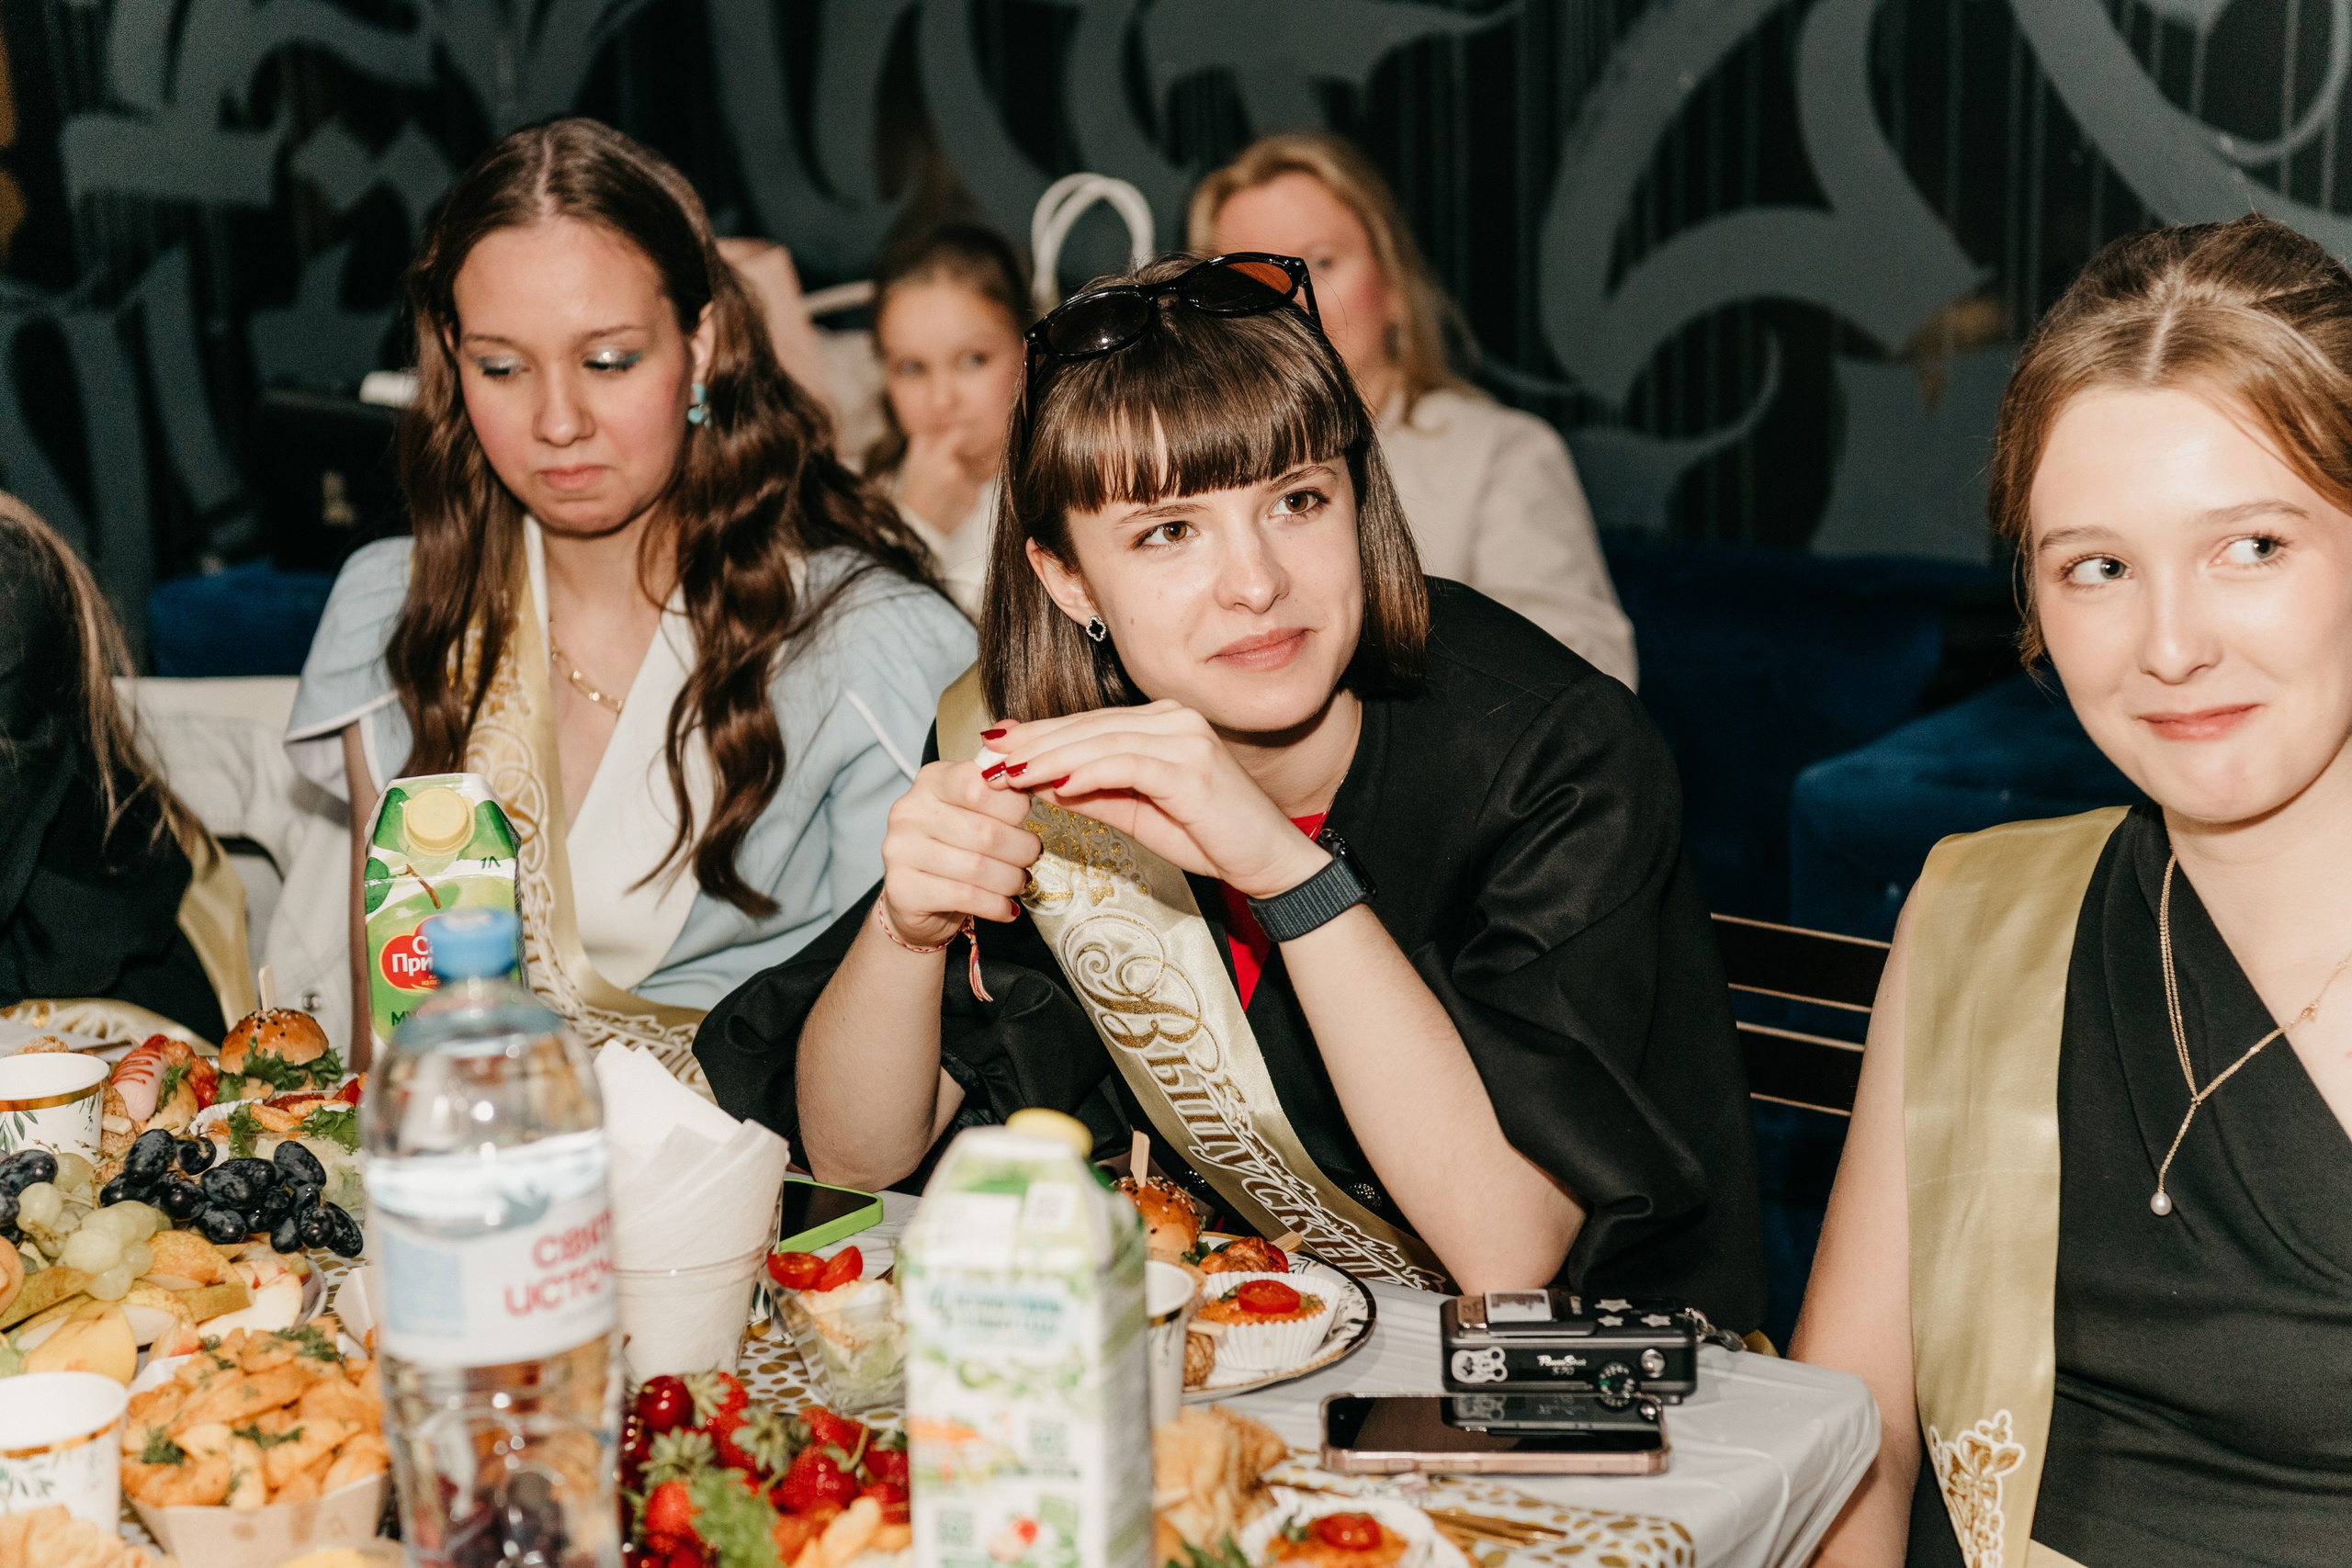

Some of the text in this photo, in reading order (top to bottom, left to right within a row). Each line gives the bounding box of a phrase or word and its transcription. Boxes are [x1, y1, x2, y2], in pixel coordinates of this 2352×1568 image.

[412, 934, 434, 955] С
[391, 952, 434, 977] При
[1536, 1354, 1588, 1367] PowerShot
